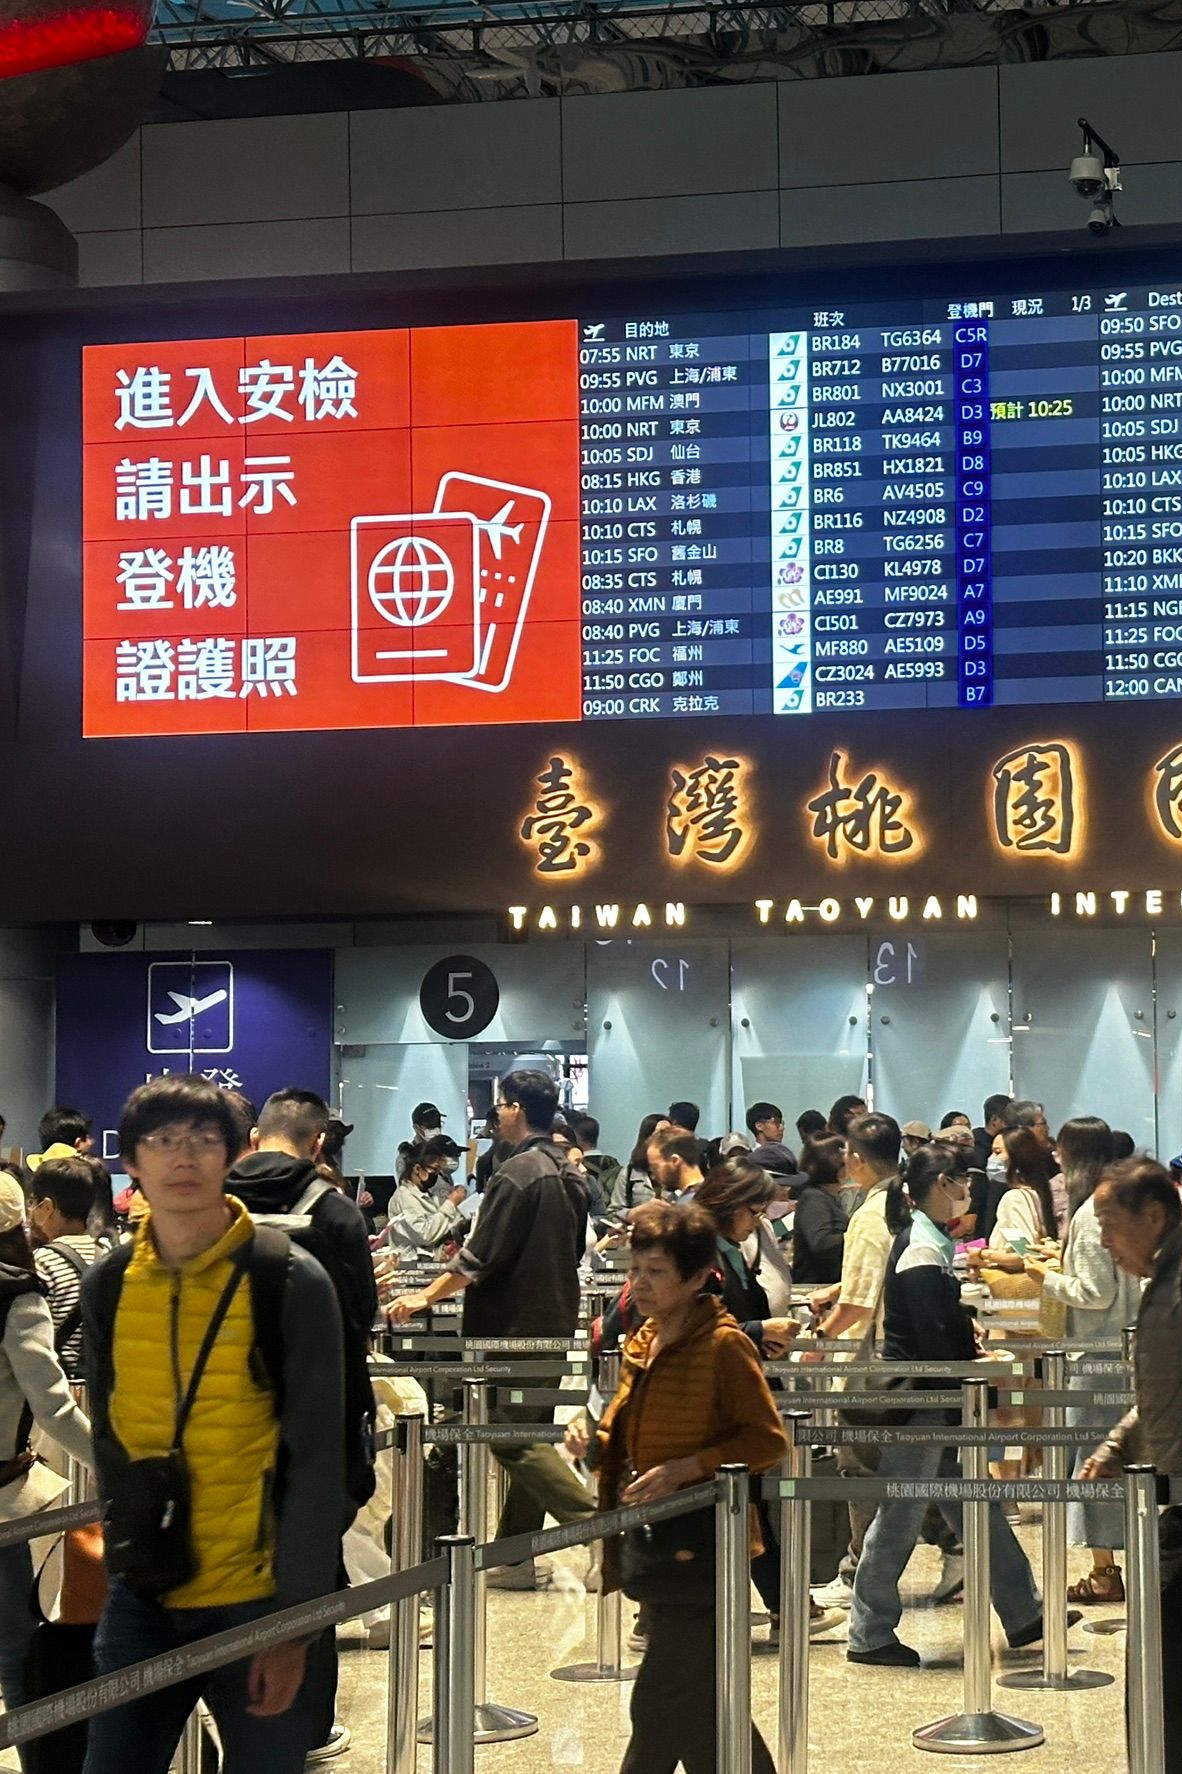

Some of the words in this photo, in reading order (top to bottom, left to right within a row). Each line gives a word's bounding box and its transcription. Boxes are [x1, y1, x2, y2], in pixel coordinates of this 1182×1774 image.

[625, 320, 670, 339] 目的地
[813, 310, 845, 328] 班次
[947, 301, 994, 320] 登機門
[1011, 298, 1044, 316] 現況
[1071, 295, 1092, 313] 1/3
[579, 347, 621, 365] 07:55
[626, 345, 658, 362] NRT
[669, 342, 700, 359] 東京
[812, 334, 861, 352] BR184
[880, 329, 942, 347] TG6364
[955, 327, 988, 343] C5R
[1100, 342, 1145, 360] 09:55
[1150, 339, 1182, 357] PVG
[115, 355, 359, 430] 進入安檢
[1102, 394, 1146, 413] 10:00
[581, 423, 622, 440] 10:00
[627, 421, 659, 437] NRT
[669, 418, 701, 435] 東京
[811, 410, 856, 429] JL802
[881, 405, 944, 425] AA8424
[961, 404, 983, 420] D3
[989, 401, 1024, 420] 預計
[1028, 399, 1073, 418] 10:25
[1102, 445, 1146, 464] 10:05
[115, 454, 297, 520] 請出示
[581, 473, 622, 490] 08:15
[627, 470, 661, 487] HKG
[670, 468, 701, 485] 香港
[813, 461, 863, 479] BR851
[883, 456, 945, 475] HX1821
[962, 455, 984, 471] D8
[582, 523, 623, 540] 10:10
[627, 521, 657, 538] CTS
[670, 519, 702, 536] 札幌
[813, 512, 863, 530] BR116
[883, 508, 946, 526] NZ4908
[962, 507, 984, 523] D2
[1103, 549, 1148, 567] 10:20
[116, 545, 237, 611] 登機
[582, 598, 624, 615] 08:40
[628, 596, 666, 613] XMN
[671, 594, 702, 611] 廈門
[813, 588, 864, 606] AE991
[884, 584, 948, 602] MF9024
[963, 583, 985, 599] A7
[1105, 627, 1148, 645] 11:25
[116, 636, 297, 703] 證護照
[583, 674, 625, 691] 11:50
[628, 672, 665, 689] CGO
[672, 670, 703, 687] 鄭州
[815, 664, 875, 682] CZ3024
[884, 661, 945, 679] AE5993
[965, 660, 986, 676] D3
[508, 902, 688, 930] TAIWAN
[755, 894, 979, 923] TAOYUAN
[444, 971, 477, 1024] 5
[409, 1365, 432, 1374] Airport
[432, 1365, 472, 1374] Corporation
[473, 1365, 483, 1373] Ltd
[484, 1365, 511, 1375] Security
[843, 1365, 868, 1374] Airport
[924, 1366, 952, 1375] Security
[802, 1396, 850, 1404] International
[851, 1396, 880, 1405] Airport
[880, 1395, 925, 1405] Corporation
[475, 1429, 511, 1440] Taoyuan
[841, 1429, 893, 1443] 機場保全
[895, 1431, 931, 1443] Taoyuan
[932, 1431, 987, 1441] International
[987, 1431, 1019, 1443] Airport
[1020, 1431, 1073, 1442] Corporation
[1074, 1431, 1090, 1441] Ltd
[886, 1482, 1060, 1499] 桃園國際機場股份有限公司
[1065, 1484, 1125, 1499] 機場保全
